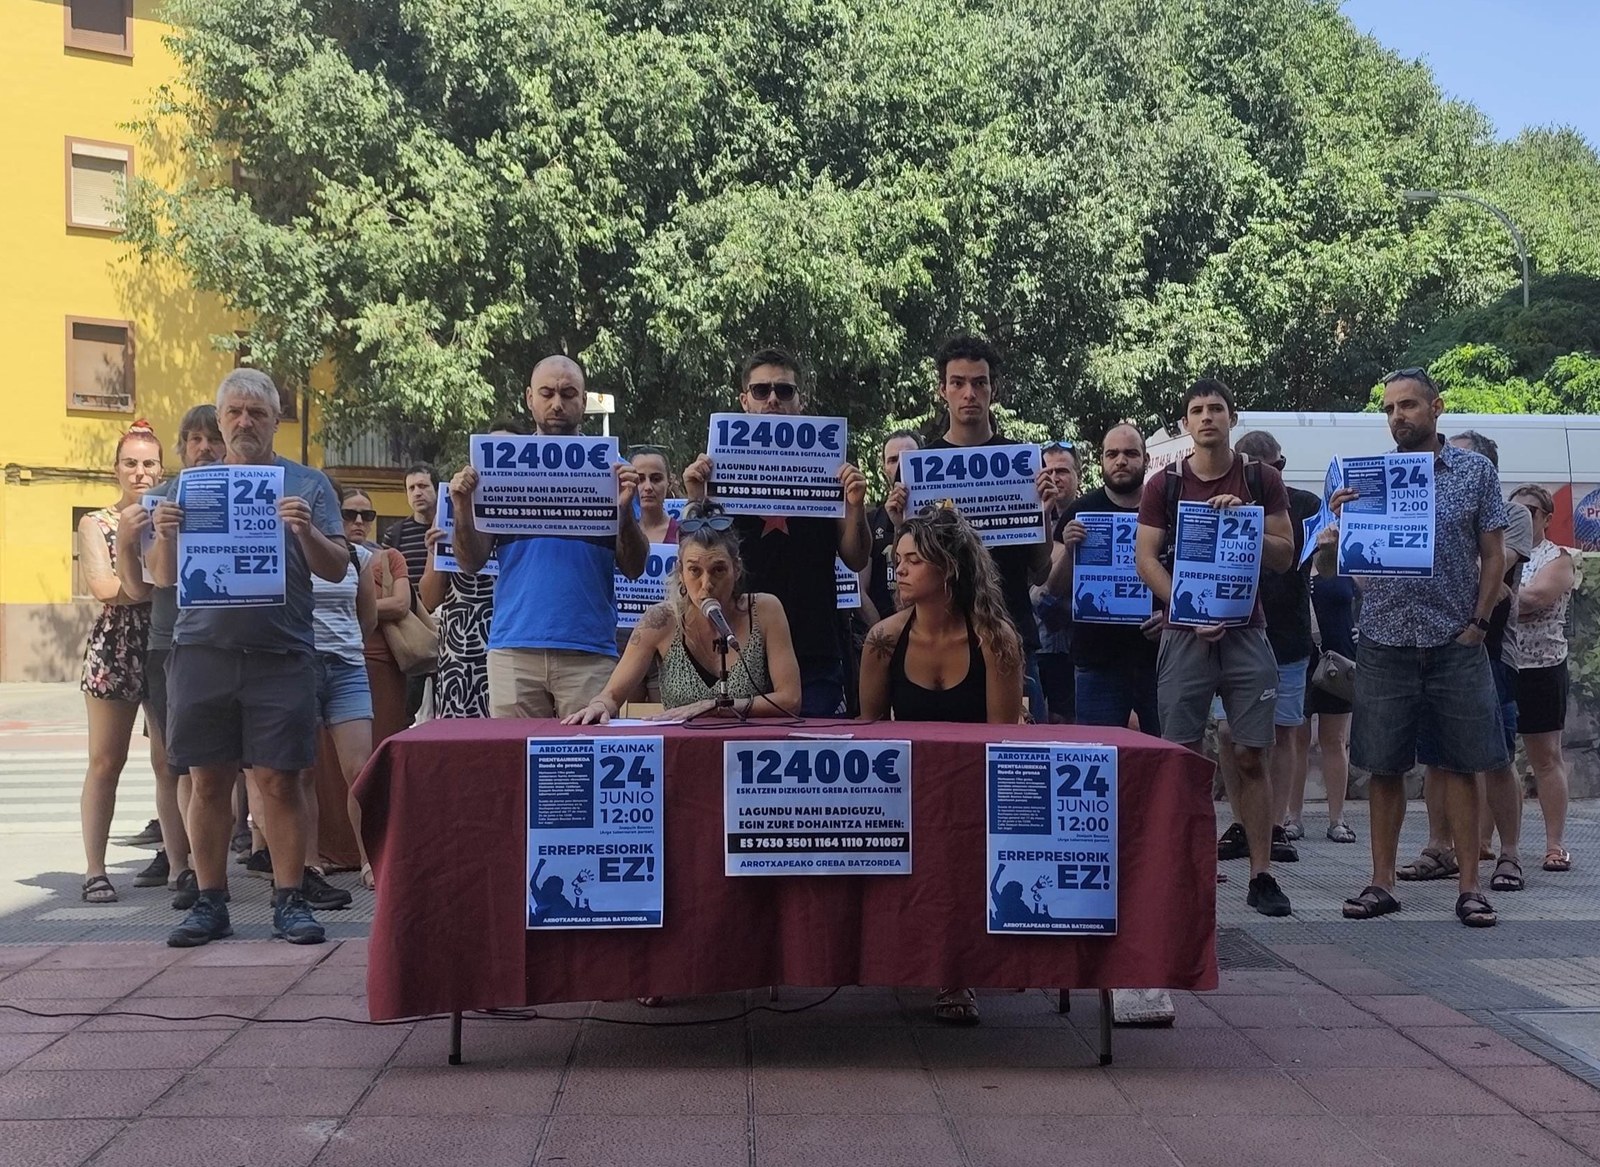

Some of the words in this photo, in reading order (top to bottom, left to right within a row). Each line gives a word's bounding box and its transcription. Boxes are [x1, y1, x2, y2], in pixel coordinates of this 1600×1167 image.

[717, 420, 839, 450] 12400€
[481, 442, 610, 469] 12400€
[782, 466, 826, 474] BADIGUZU,
[910, 451, 1033, 482] 12400€
[760, 475, 808, 483] DOHAINTZA
[1389, 466, 1428, 489] 24
[233, 480, 276, 504] 24
[979, 494, 1022, 502] BADIGUZU,
[1391, 489, 1428, 499] JUNIO
[233, 506, 276, 516] JUNIO
[1392, 501, 1428, 512] 12:00
[234, 519, 276, 530] 12:00
[1222, 518, 1258, 540] 24
[1348, 523, 1427, 531] ERREPRESIORIK
[1221, 541, 1256, 550] JUNIO
[1389, 533, 1428, 548] EZ!
[1220, 552, 1255, 563] 12:00
[234, 556, 278, 574] EZ!
[1179, 571, 1252, 582] ERREPRESIORIK
[1115, 583, 1147, 598] EZ!
[1216, 582, 1252, 599] EZ!
[601, 744, 654, 753] EKAINAK
[1057, 754, 1109, 762] EKAINAK
[600, 756, 654, 789] 24
[737, 749, 900, 784] 12400€
[1056, 765, 1109, 797] 24
[600, 791, 654, 804] JUNIO
[739, 807, 792, 816] LAGUNDU
[795, 807, 822, 815] NAHI
[825, 807, 885, 816] BADIGUZU,
[1057, 800, 1109, 812] JUNIO
[600, 808, 653, 823] 12:00
[739, 821, 764, 829] EGIN
[1058, 816, 1108, 831] 12:00
[740, 839, 753, 847] ES
[756, 839, 782, 847] 7630
[786, 839, 812, 847] 3501
[815, 839, 838, 847] 1164
[841, 838, 863, 847] 1110
[866, 838, 904, 847] 701087
[539, 844, 653, 855] ERREPRESIORIK
[998, 851, 1109, 862] ERREPRESIORIK
[600, 857, 654, 882] EZ!
[1058, 864, 1110, 890] EZ!
